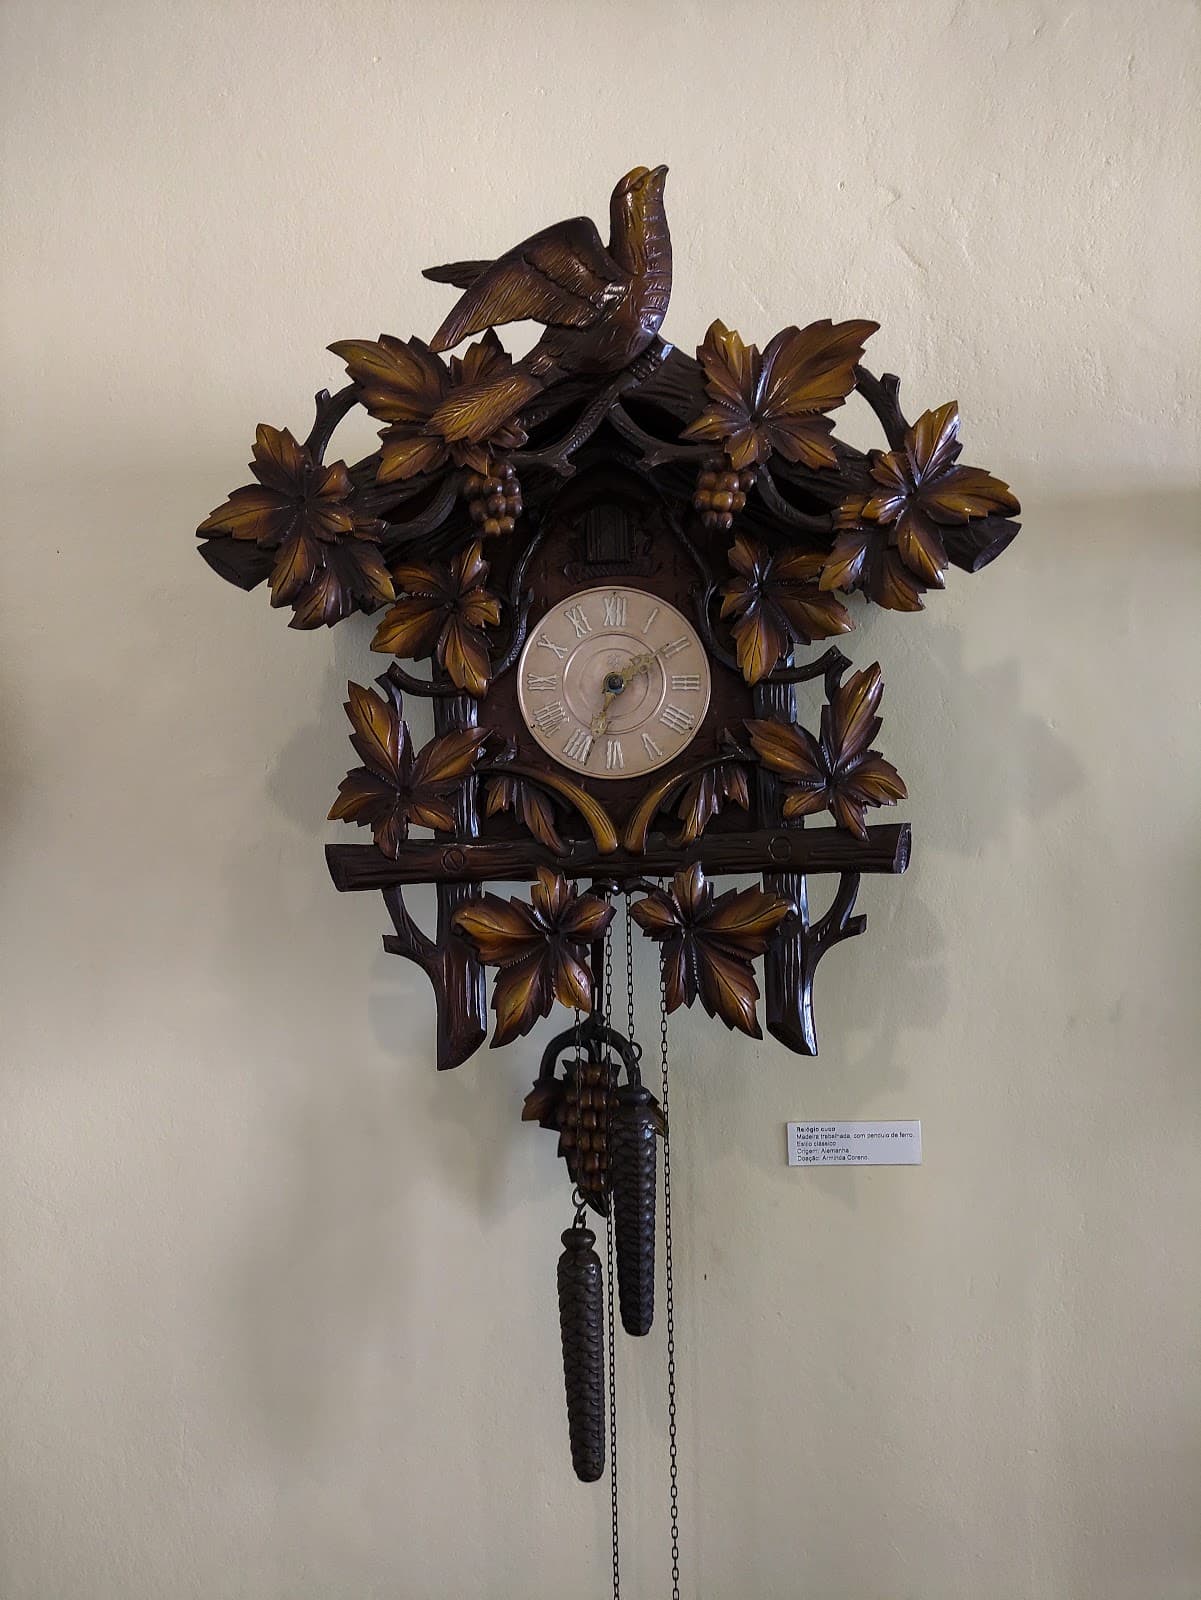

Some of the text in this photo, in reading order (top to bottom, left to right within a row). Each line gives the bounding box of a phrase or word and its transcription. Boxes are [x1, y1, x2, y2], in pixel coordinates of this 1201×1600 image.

[564, 604, 592, 638] XI
[603, 596, 628, 627] XII
[643, 608, 659, 634] I
[537, 634, 568, 659] X
[527, 673, 557, 691] IX
[671, 674, 700, 691] III
[534, 700, 570, 739] VIII
[605, 739, 624, 770] VI
[642, 733, 663, 761] V
